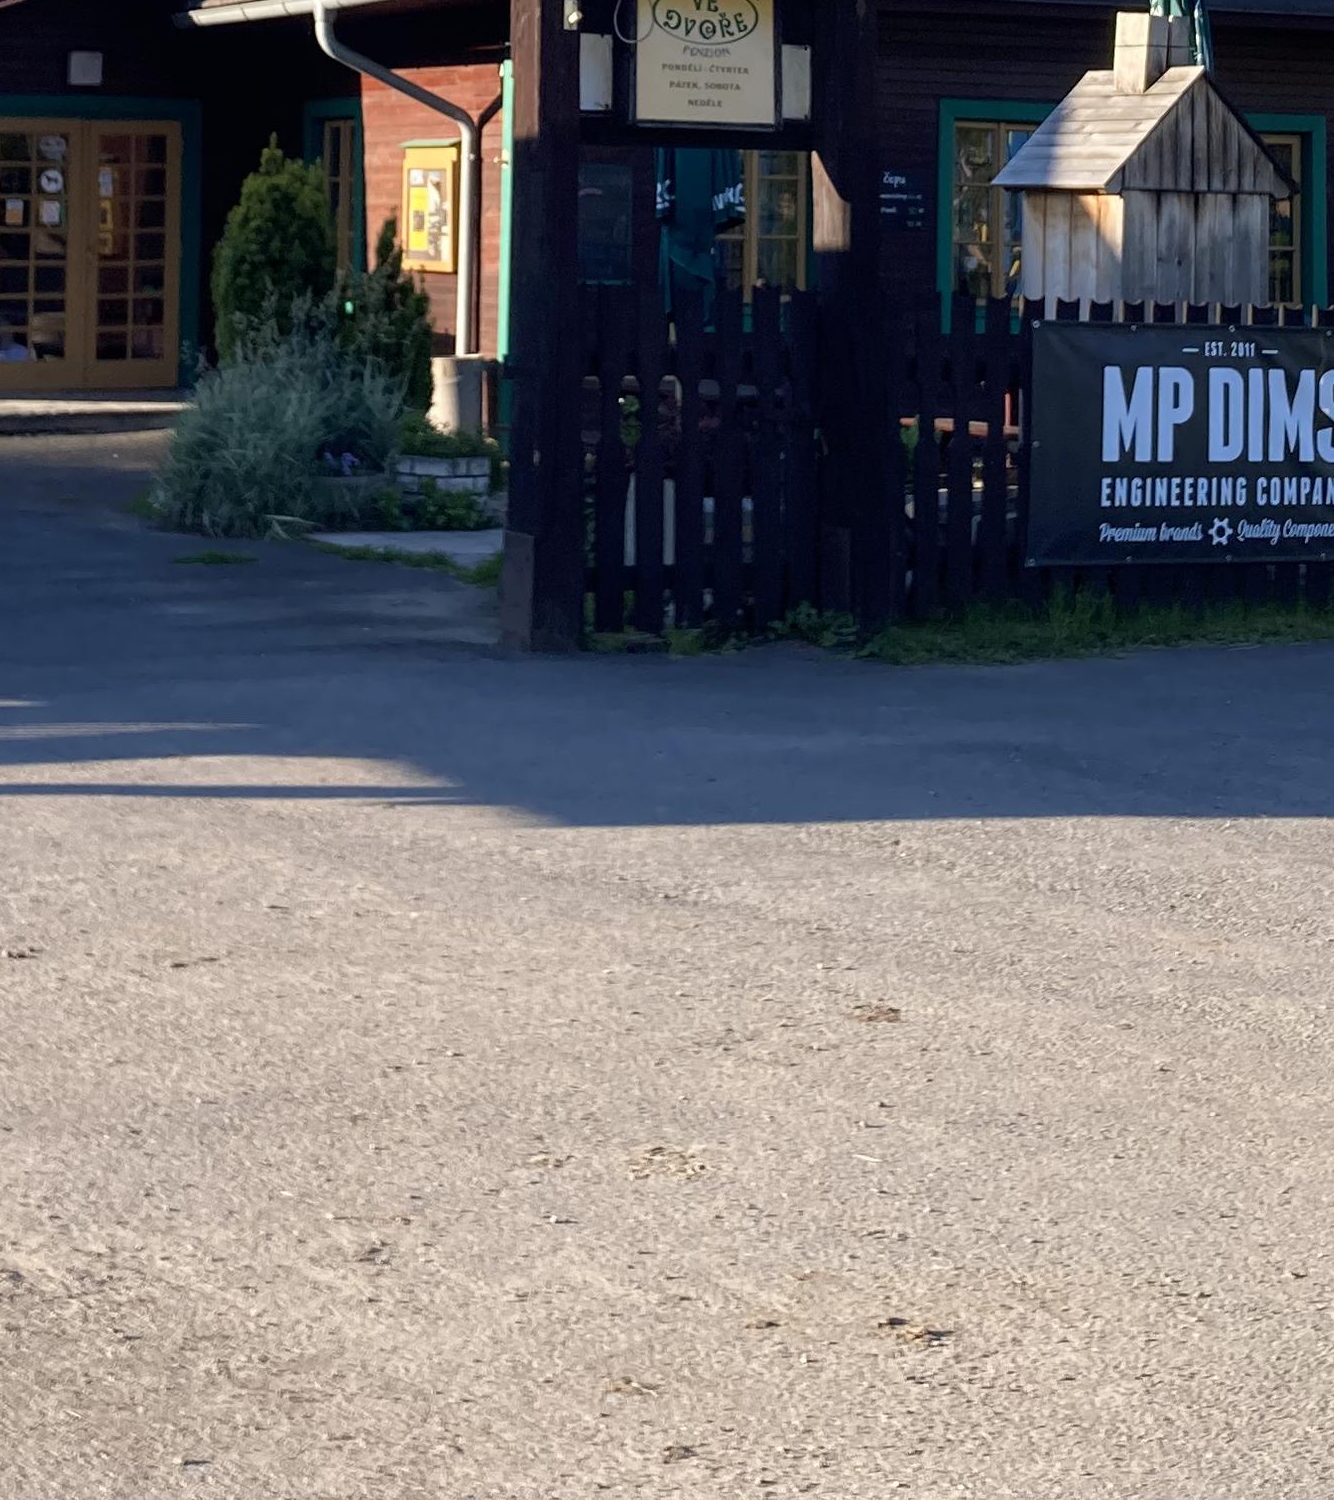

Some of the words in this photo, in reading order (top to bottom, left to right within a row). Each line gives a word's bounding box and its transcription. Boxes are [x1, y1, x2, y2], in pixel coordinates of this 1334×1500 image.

[663, 9, 748, 40] DVOŘE
[704, 81, 741, 91] SOBOTA
[687, 98, 723, 108] NEDĚLE
[1204, 341, 1227, 357] EST.
[1231, 342, 1255, 358] 2011
[1101, 365, 1195, 463] MP
[1100, 476, 1247, 508] ENGINEERING
[1099, 522, 1156, 543] Premium
[1236, 518, 1281, 545] Quality
